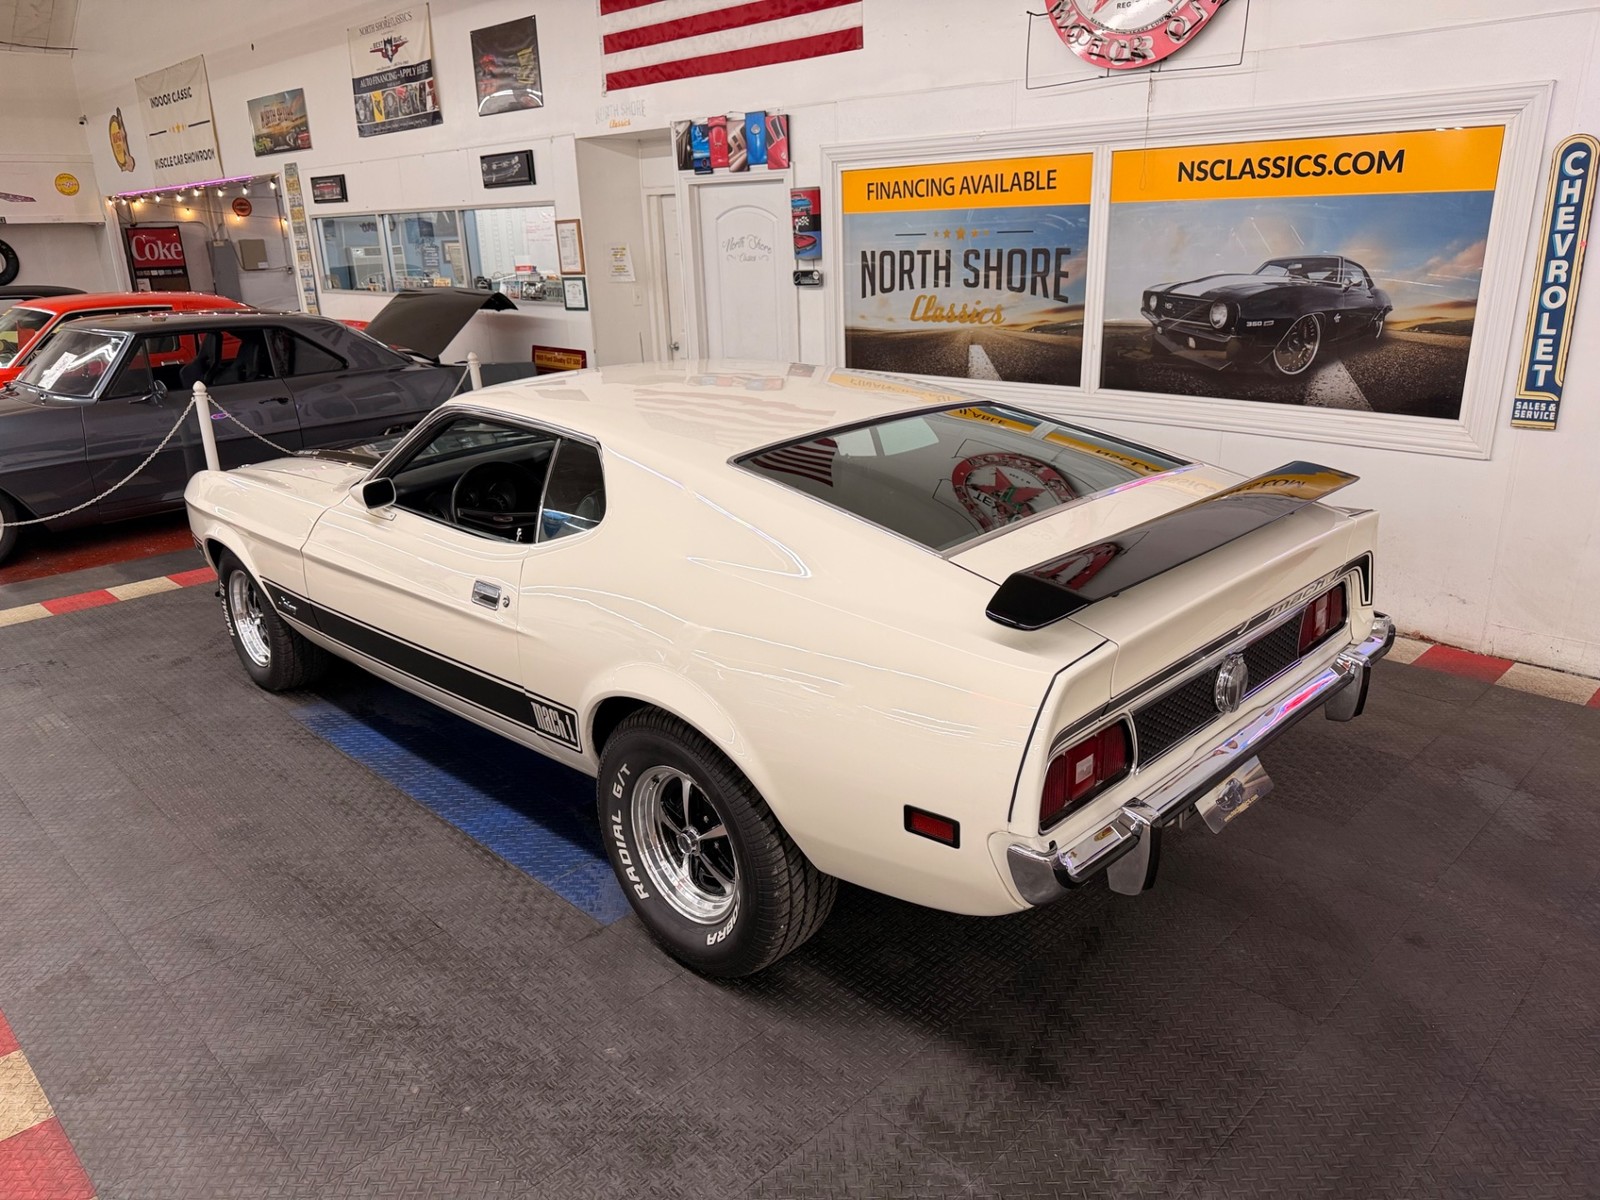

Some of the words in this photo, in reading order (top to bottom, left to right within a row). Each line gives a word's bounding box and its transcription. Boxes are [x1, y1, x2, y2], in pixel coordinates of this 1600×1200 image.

[399, 66, 417, 79] APPLY
[149, 94, 172, 108] INDOOR
[154, 156, 174, 170] MUSCLE
[174, 154, 184, 166] CAR
[184, 148, 216, 164] SHOWROOM
[1176, 149, 1405, 183] NSCLASSICS.COM
[866, 176, 956, 201] FINANCING
[959, 169, 1057, 195] AVAILABLE
[131, 235, 184, 261] Coke
[860, 249, 952, 299] NORTH
[962, 247, 1072, 304] SHORE
[1531, 150, 1588, 388] CHEVROLET
[909, 294, 1006, 325] Classics
[1513, 410, 1556, 420] SERVICE
[1515, 401, 1547, 411] SALES
[1548, 403, 1557, 412] &
[612, 763, 631, 799] G/T
[611, 809, 651, 900] RADIAL
[706, 899, 741, 946] OBRA
